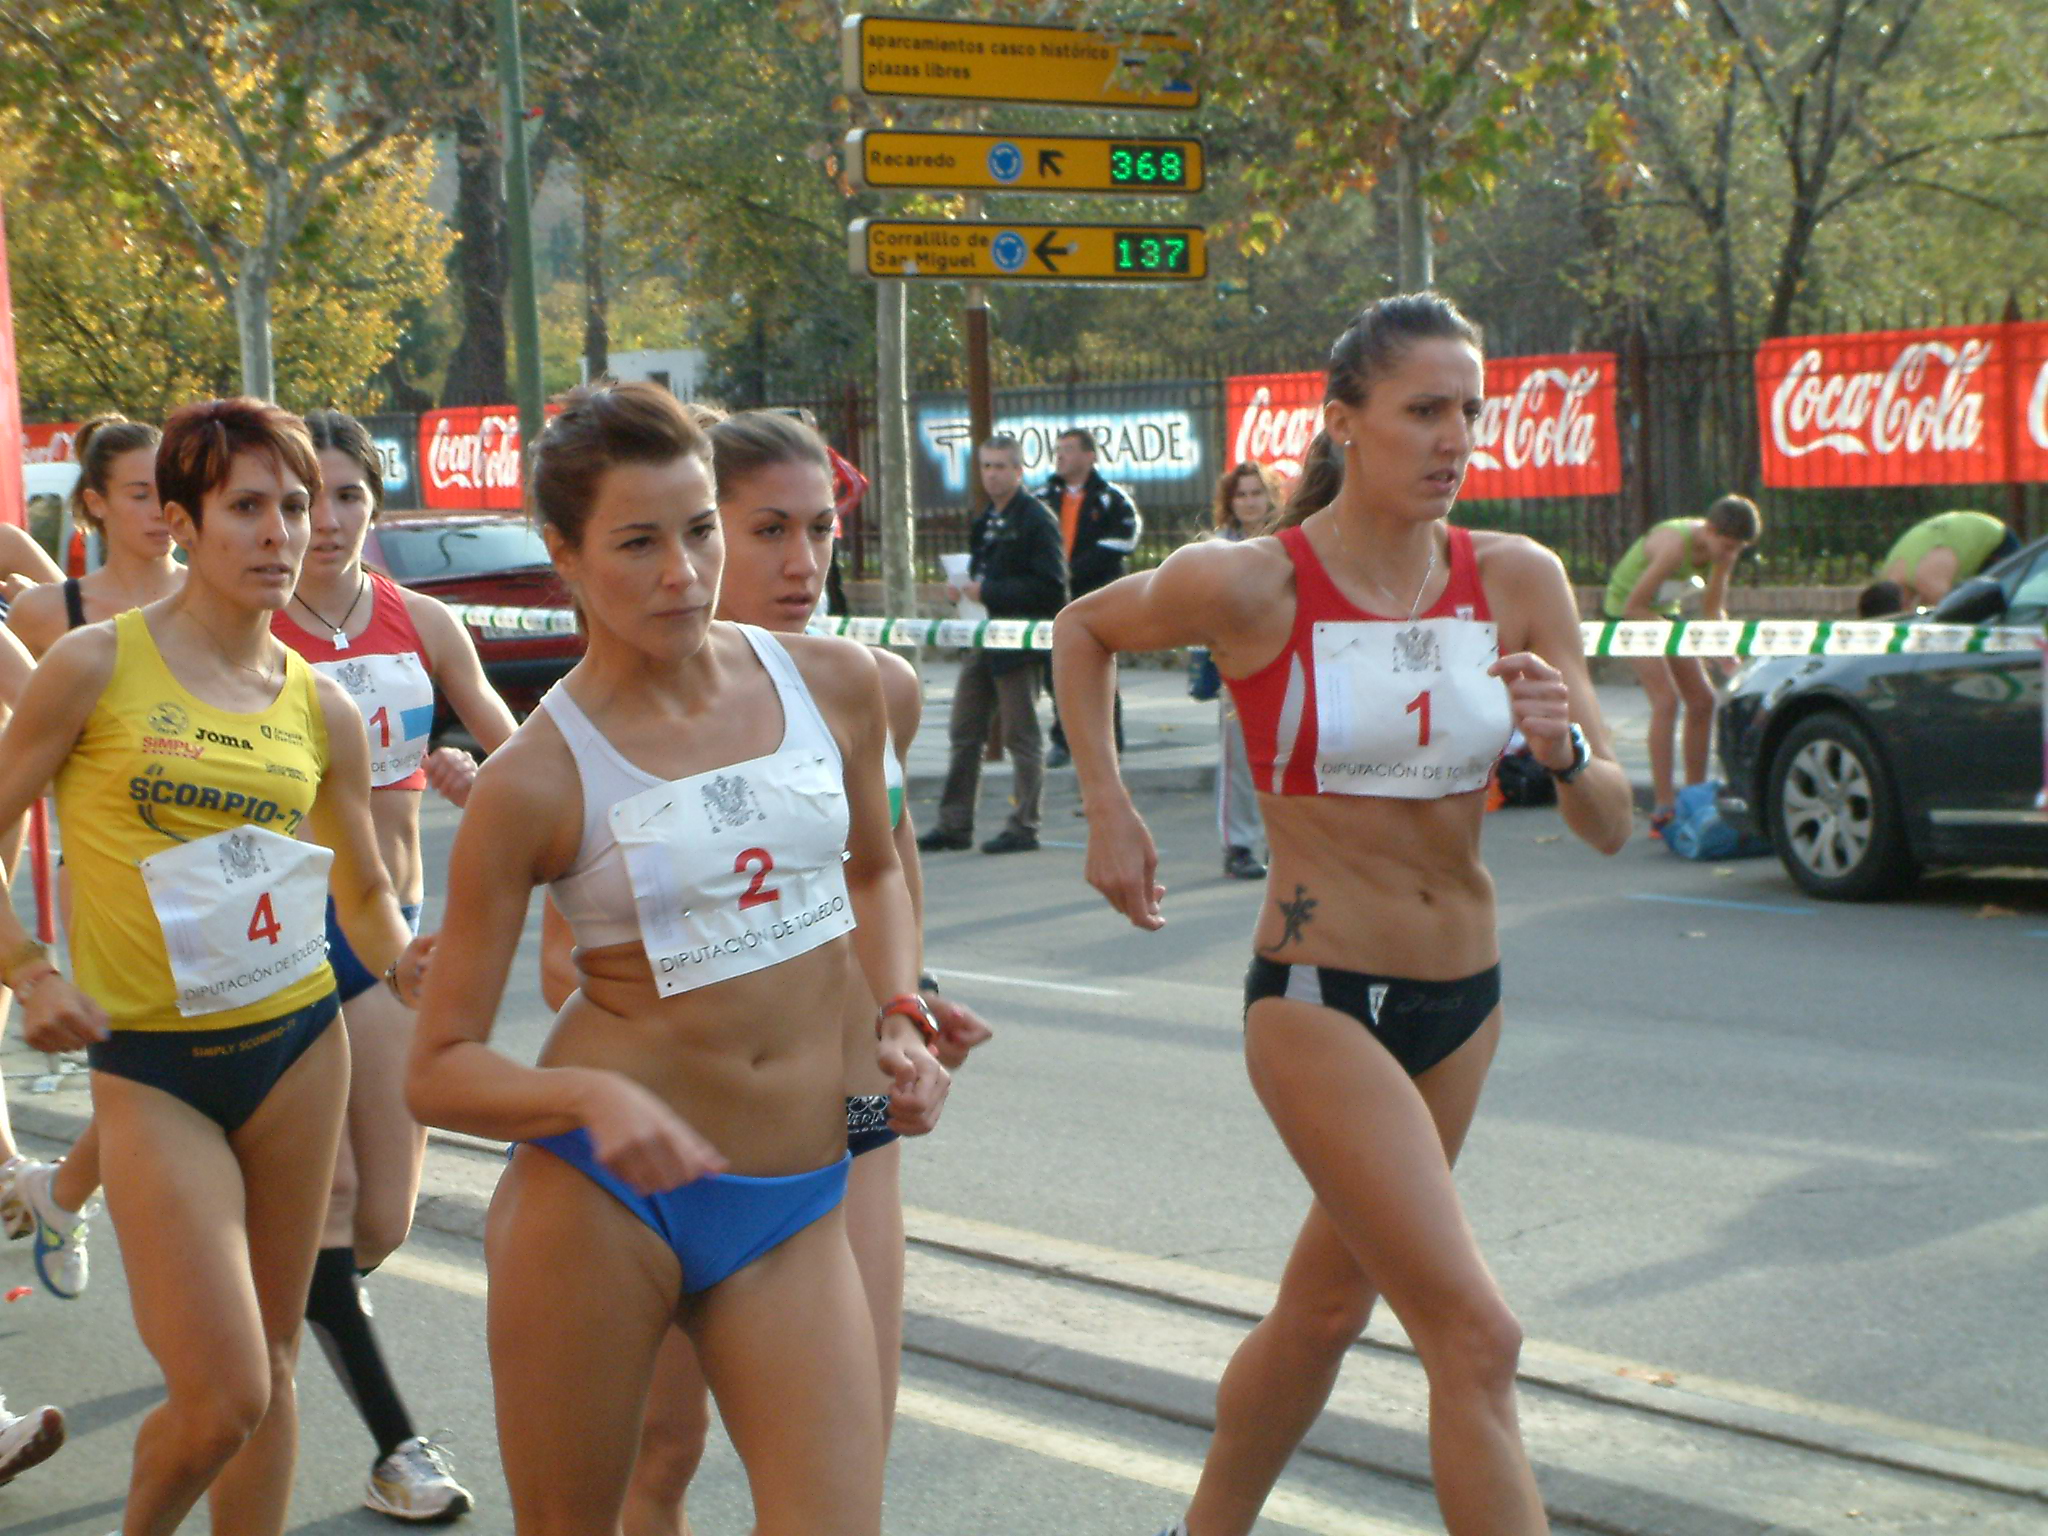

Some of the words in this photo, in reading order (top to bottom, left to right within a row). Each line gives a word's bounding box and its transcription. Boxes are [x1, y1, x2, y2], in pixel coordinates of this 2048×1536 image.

[868, 34, 984, 54] aparcamientos
[991, 43, 1036, 56] casco
[868, 60, 920, 78] plazas
[925, 62, 971, 79] libres
[871, 151, 956, 168] Recaredo
[1112, 151, 1182, 181] 368
[873, 231, 961, 247] Corralillo
[968, 232, 989, 247] de
[1119, 239, 1185, 268] 137
[916, 252, 976, 272] Miguel
[1472, 366, 1599, 470] a-Cola
[1771, 338, 1994, 458] Coca-Cola
[999, 422, 1184, 469] ORADE
[1235, 386, 1324, 478] Coca-
[369, 706, 390, 748] 1
[1405, 690, 1431, 747] 1
[1322, 761, 1418, 779] DIPUTACIÓN
[1423, 765, 1444, 781] DE
[734, 847, 780, 912] 2
[248, 892, 282, 945] 4
[659, 929, 769, 974] DIPUTACIÓN
[773, 920, 795, 941] DE
[798, 896, 845, 931] TOLEDO
[184, 966, 272, 1001] DIPUTACIÓN
[275, 960, 290, 975] DE
